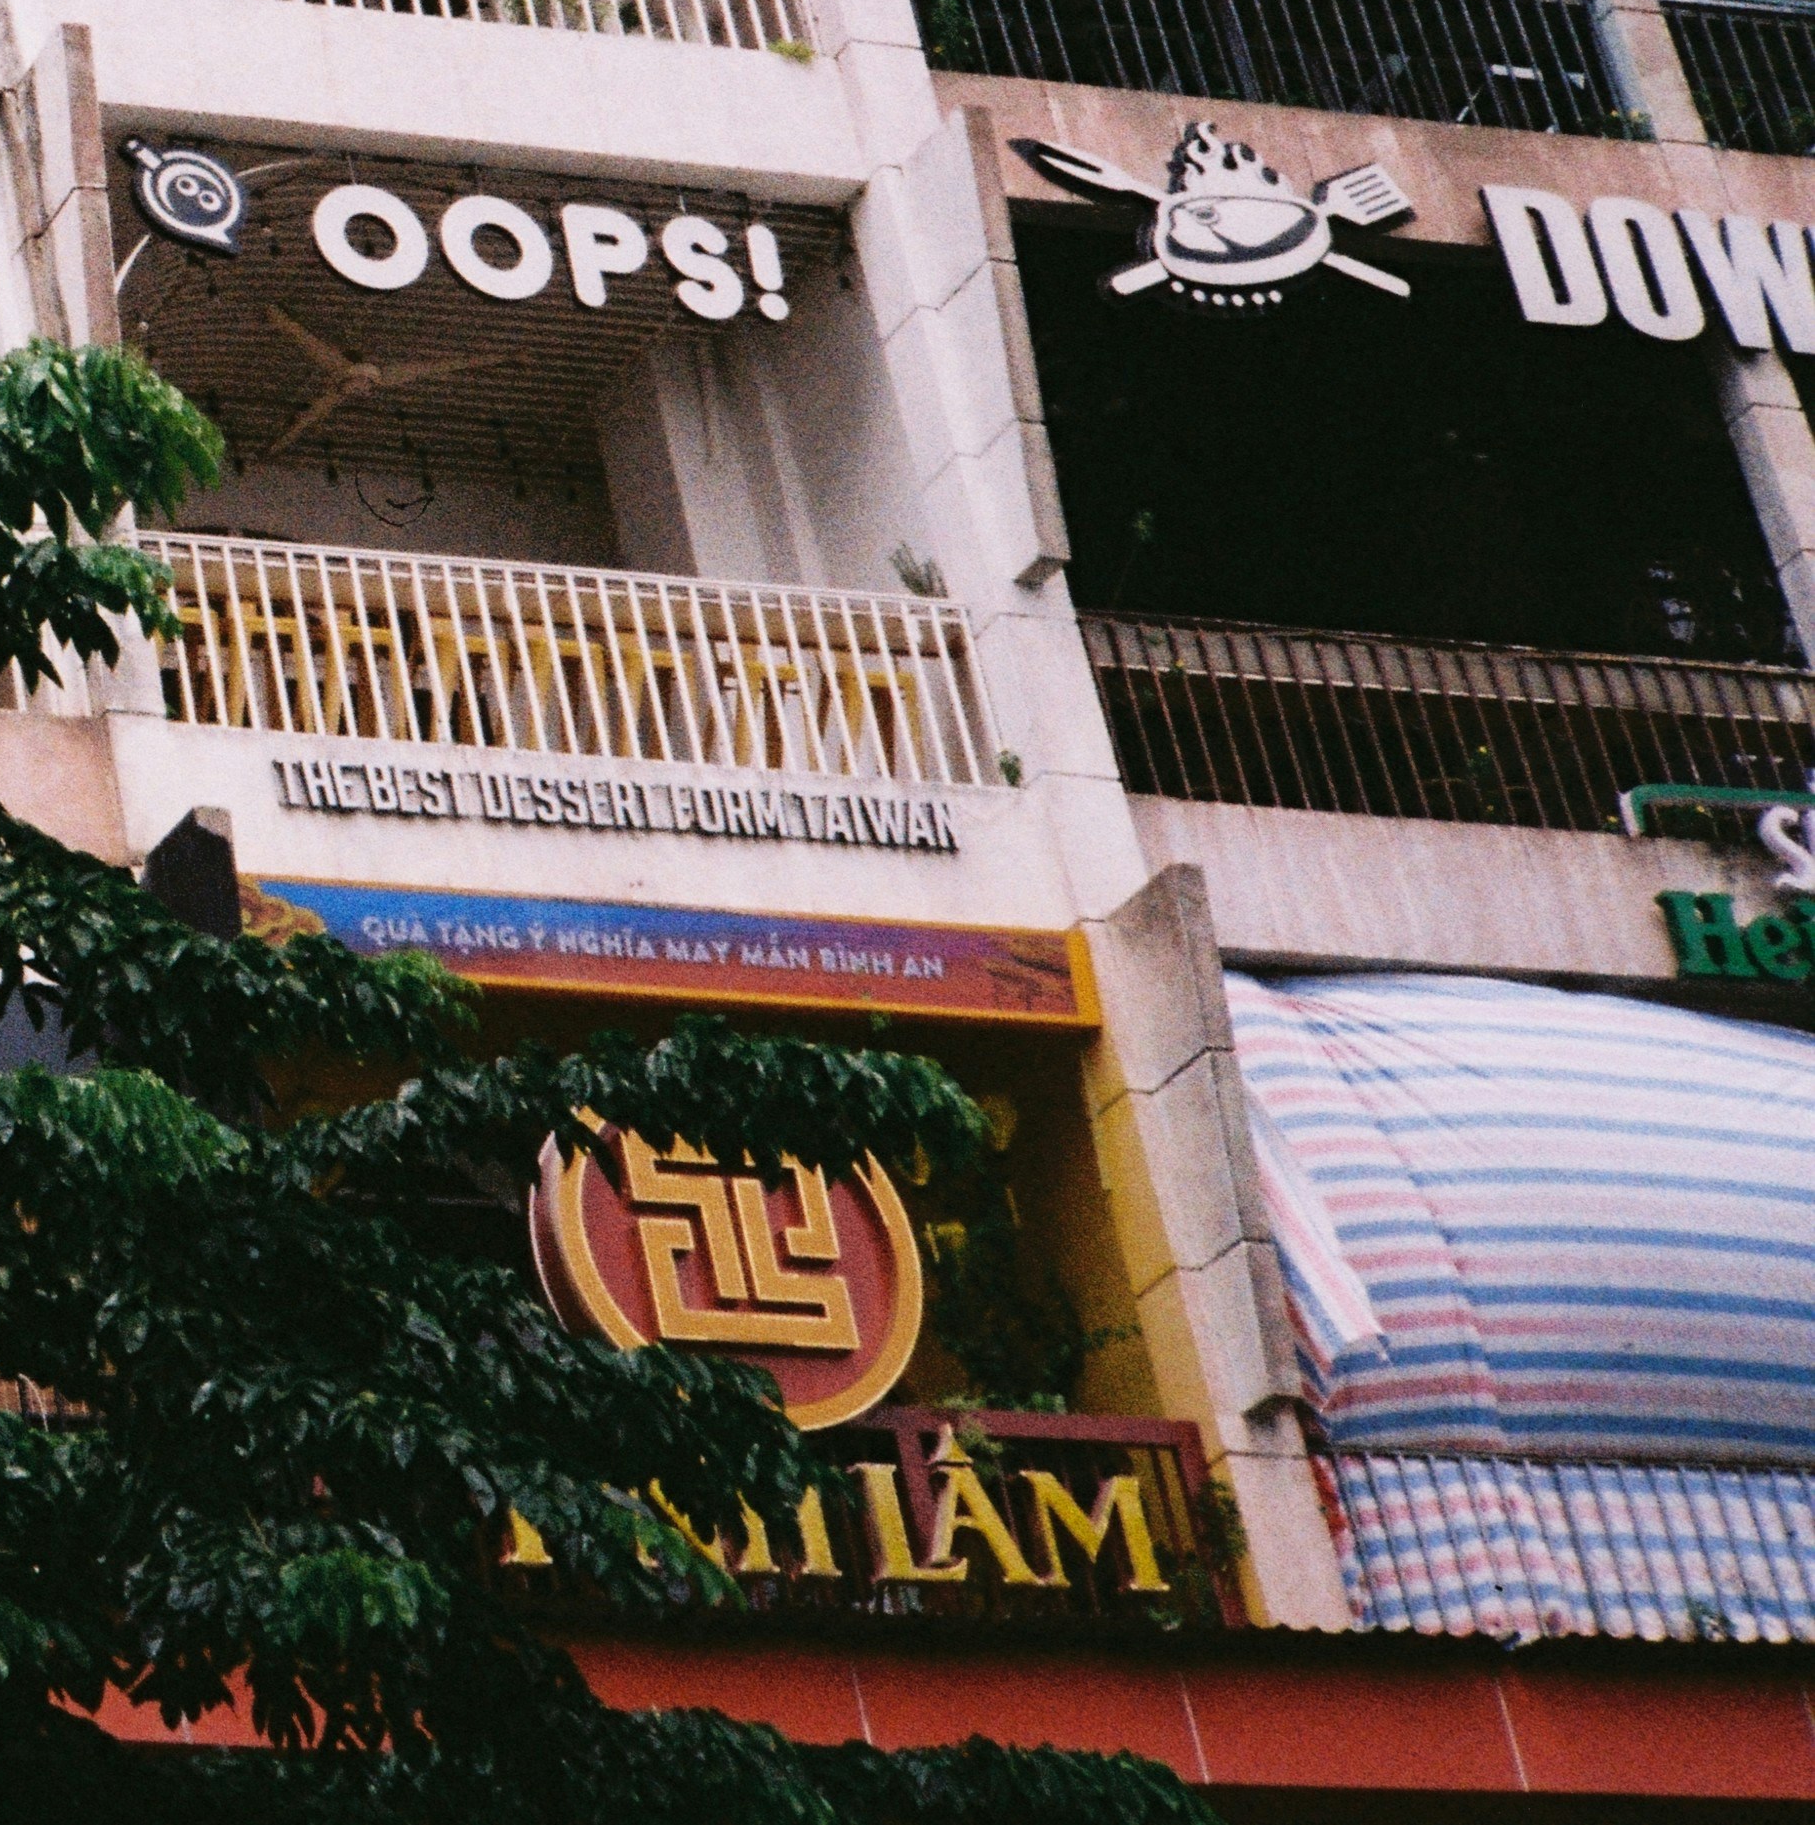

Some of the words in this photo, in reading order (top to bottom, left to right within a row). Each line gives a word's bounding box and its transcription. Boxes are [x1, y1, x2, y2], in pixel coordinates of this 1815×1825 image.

[312, 182, 790, 322] OOPS!
[1477, 183, 1815, 355] DOW
[272, 758, 363, 813] THE
[367, 766, 477, 821] BEST
[482, 774, 667, 835] DESSERT
[670, 784, 787, 841] FORM
[791, 790, 960, 856] TAIWAN
[361, 912, 429, 946] QUÀ
[664, 938, 731, 964] MAY
[902, 954, 945, 978] AN
[1653, 889, 1815, 980] He
[847, 1423, 1172, 1592] LÂM
